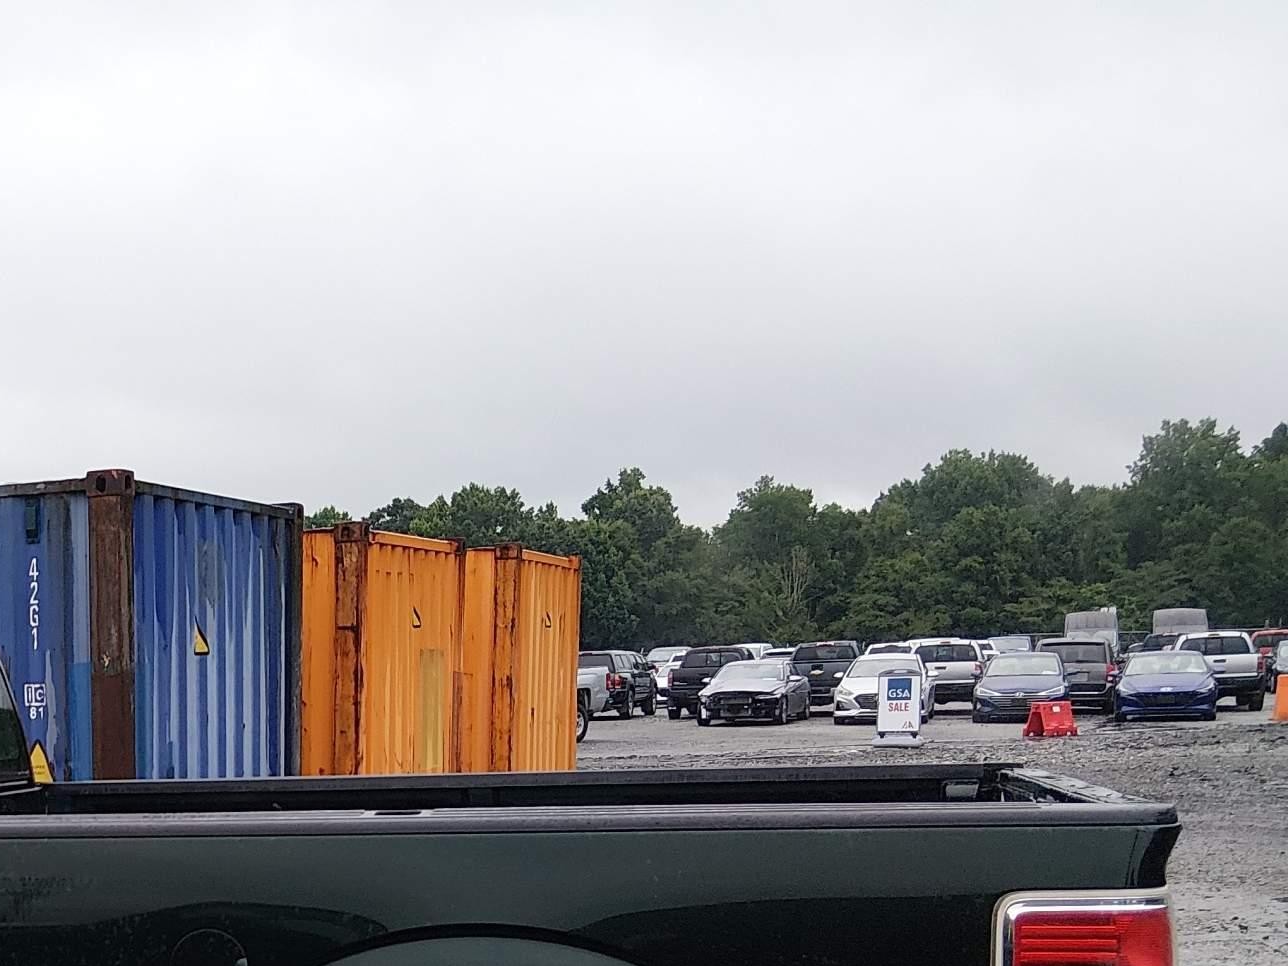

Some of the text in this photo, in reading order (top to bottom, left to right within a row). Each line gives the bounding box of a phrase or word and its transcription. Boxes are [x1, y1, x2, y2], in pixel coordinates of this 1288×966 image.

[29, 558, 39, 650] 42G1
[888, 688, 911, 698] GSA
[29, 706, 44, 720] 81
[888, 702, 910, 712] SALE
